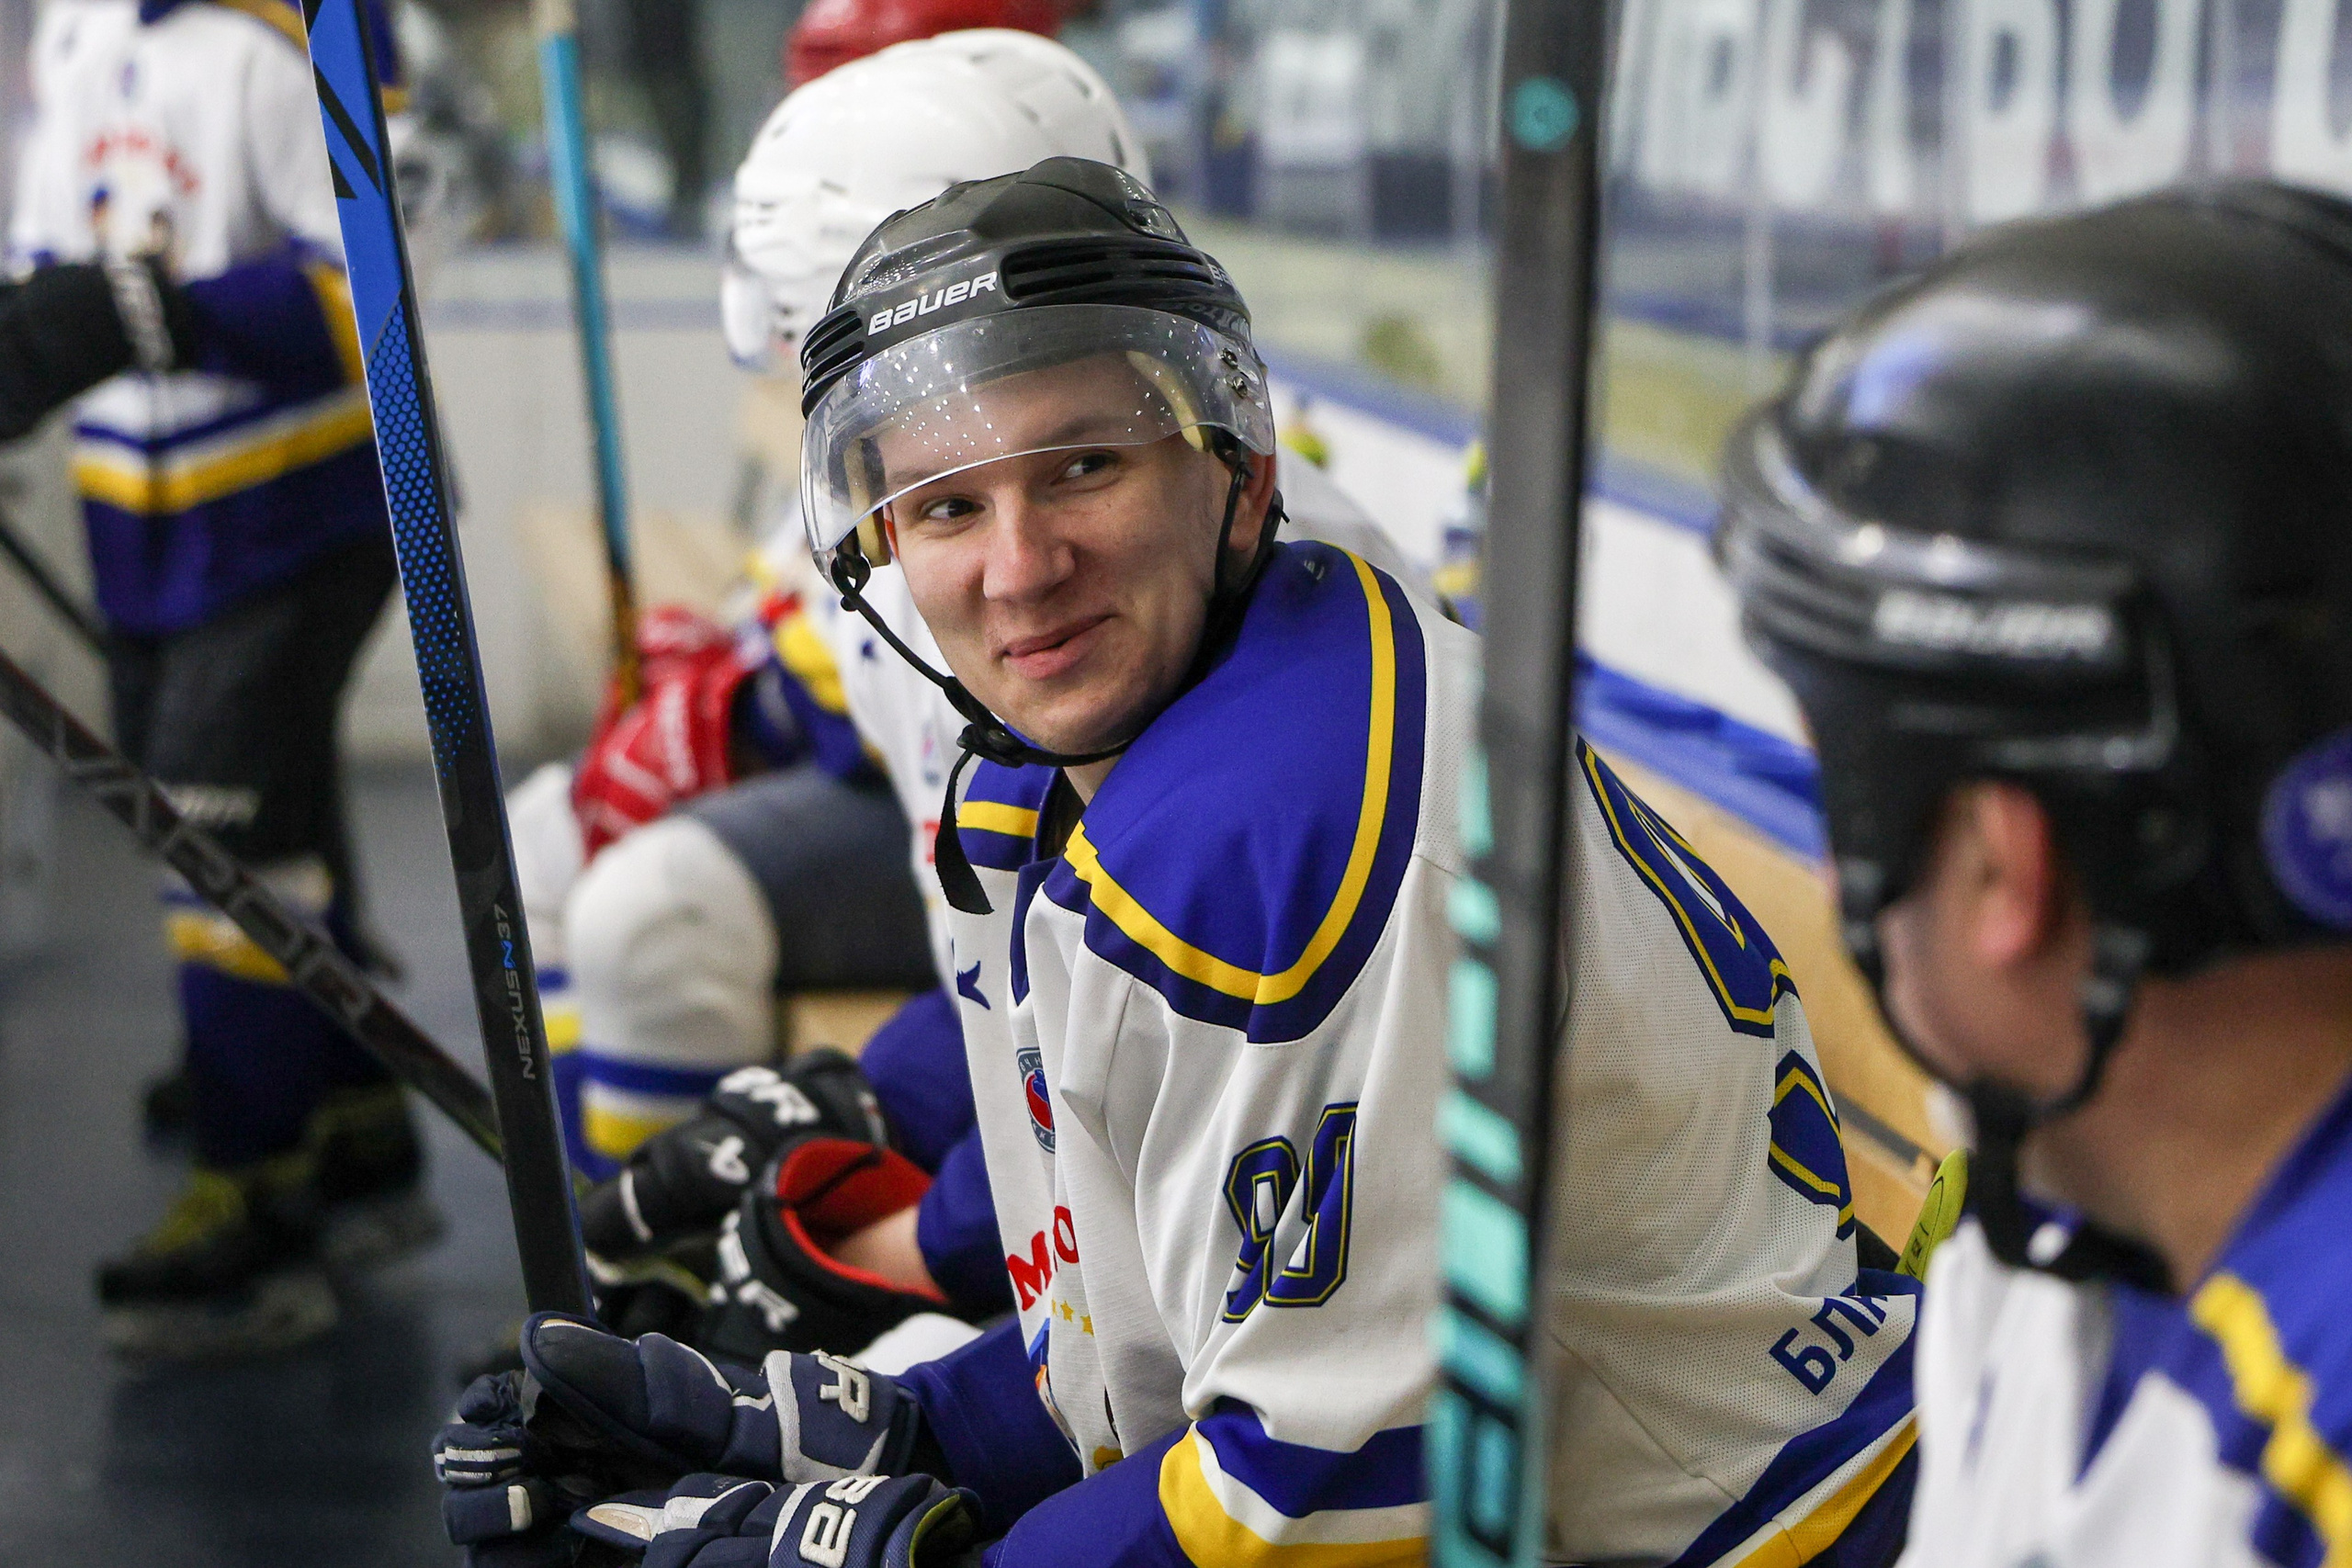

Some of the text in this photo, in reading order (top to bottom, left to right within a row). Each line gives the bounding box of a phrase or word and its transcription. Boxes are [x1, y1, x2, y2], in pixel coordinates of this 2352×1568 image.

[867, 271, 998, 336] BAUER
[55, 707, 377, 1027] VAPOR
[1223, 1101, 1360, 1324] 90
